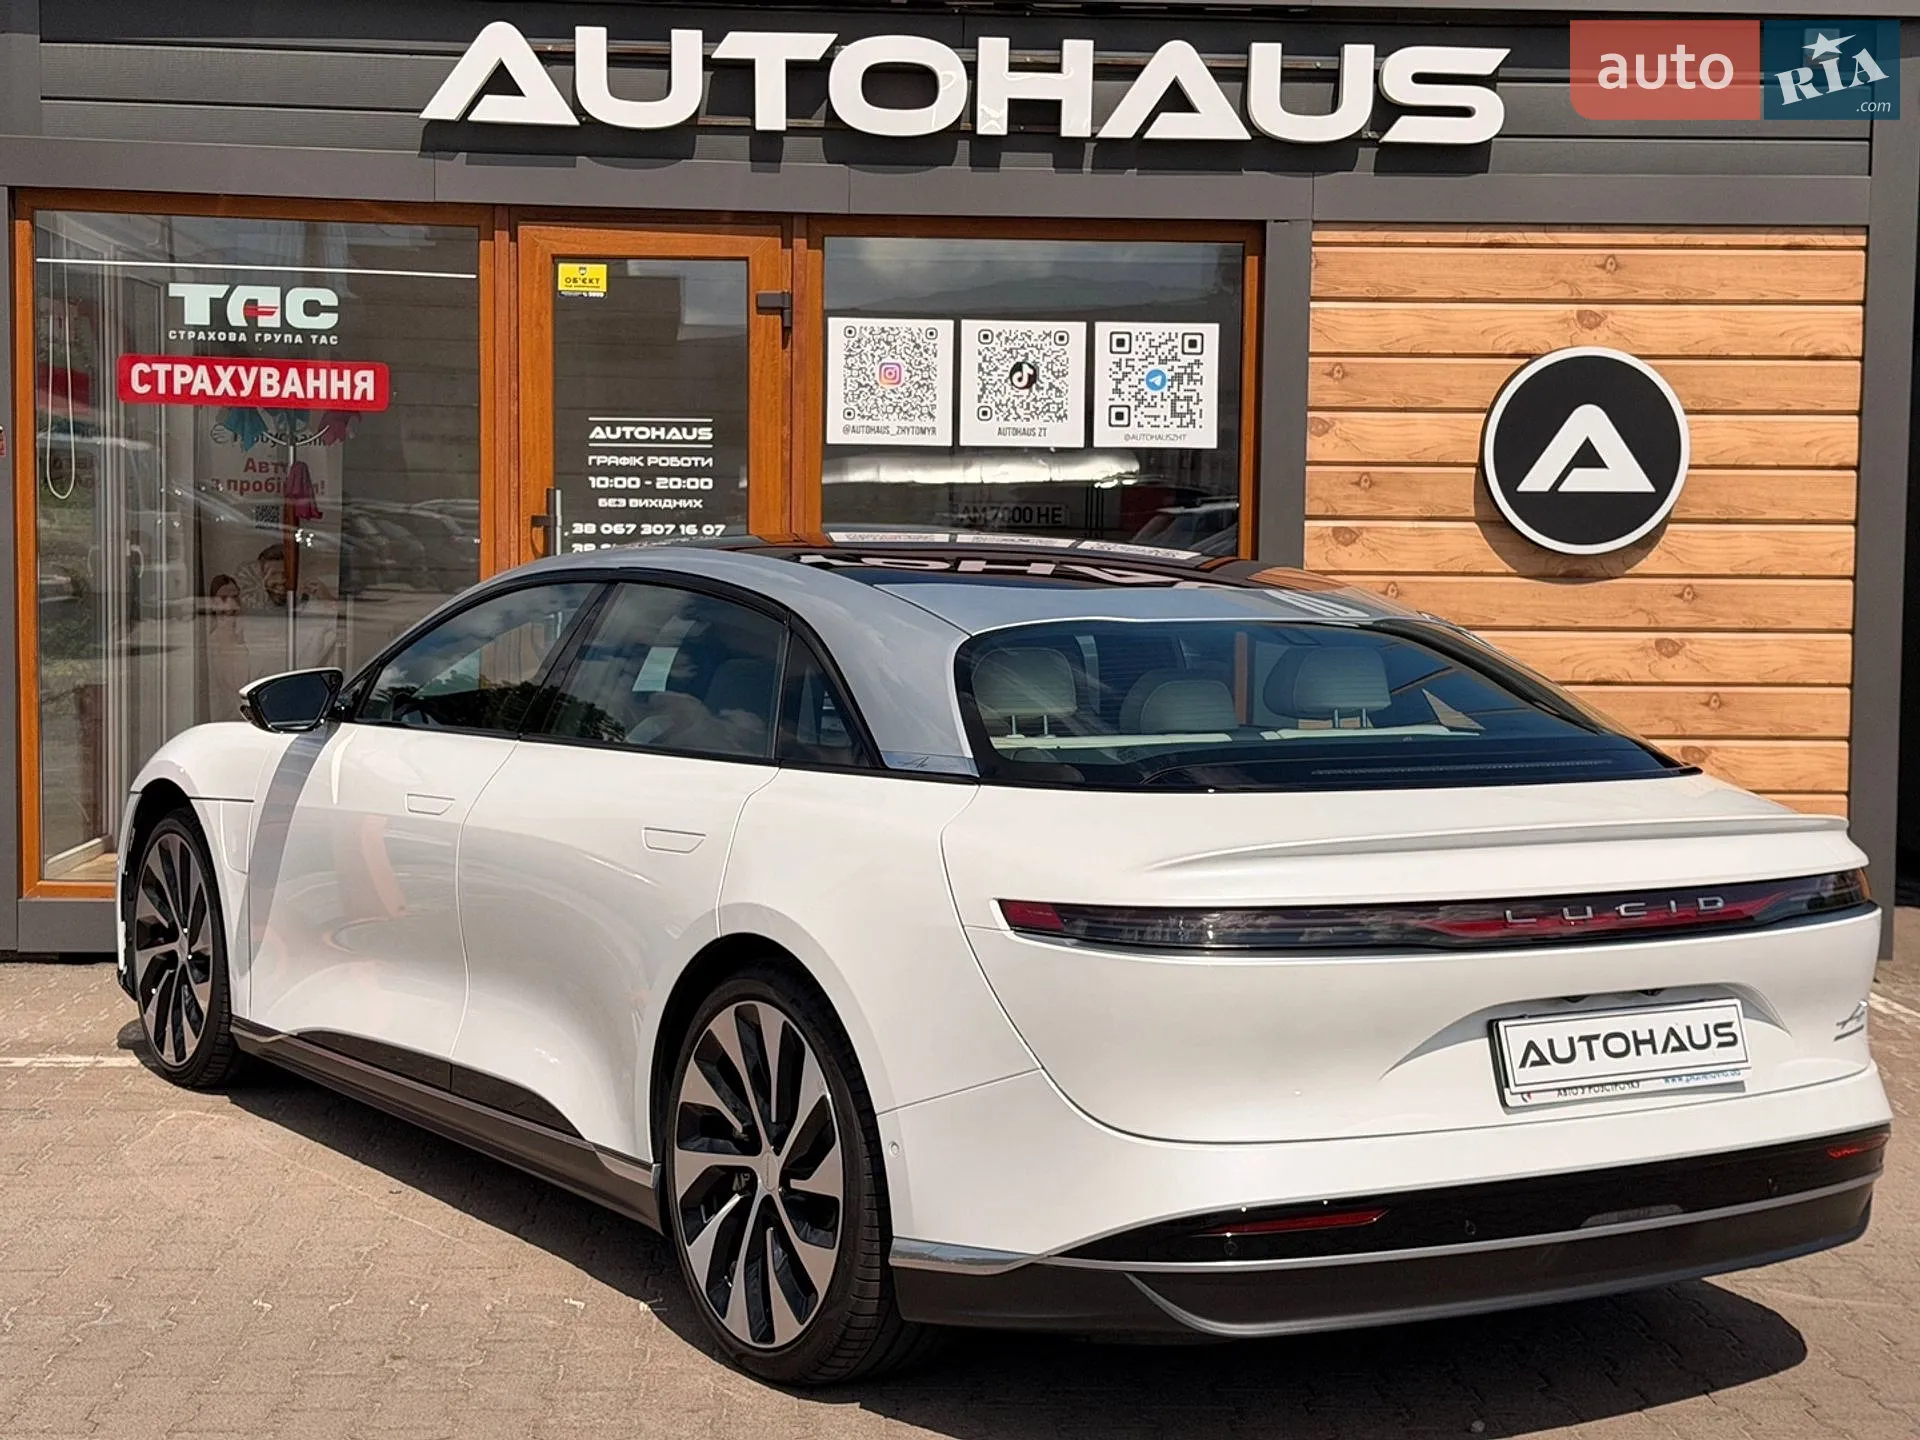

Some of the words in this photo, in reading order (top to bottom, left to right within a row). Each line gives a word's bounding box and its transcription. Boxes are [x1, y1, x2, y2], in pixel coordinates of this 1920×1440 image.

[420, 22, 1510, 146] AUTOHAUS
[168, 329, 247, 343] СТРАХОВА
[254, 332, 303, 345] ГРУПА
[310, 335, 339, 345] ТАС
[130, 362, 376, 402] СТРАХУВАННЯ
[588, 426, 714, 441] AUTOHAUS
[842, 424, 936, 436] @AUTOHAUS_ZHYTOMYR
[997, 427, 1036, 437] AUTOHAUS
[1038, 428, 1048, 438] ZT
[588, 455, 644, 468] ГРАФІК
[647, 457, 714, 469] РОБОТИ
[588, 476, 641, 489] 10:00
[655, 477, 714, 490] 20:00
[598, 497, 627, 509] БЕЗ
[629, 498, 704, 511] ВИХІДНИХ
[601, 524, 637, 535] 067
[640, 524, 676, 535] 307
[679, 525, 698, 535] 16
[701, 525, 726, 537] 07
[1505, 896, 1725, 924] LUCID
[1518, 1020, 1739, 1069] AUTOHAUS
